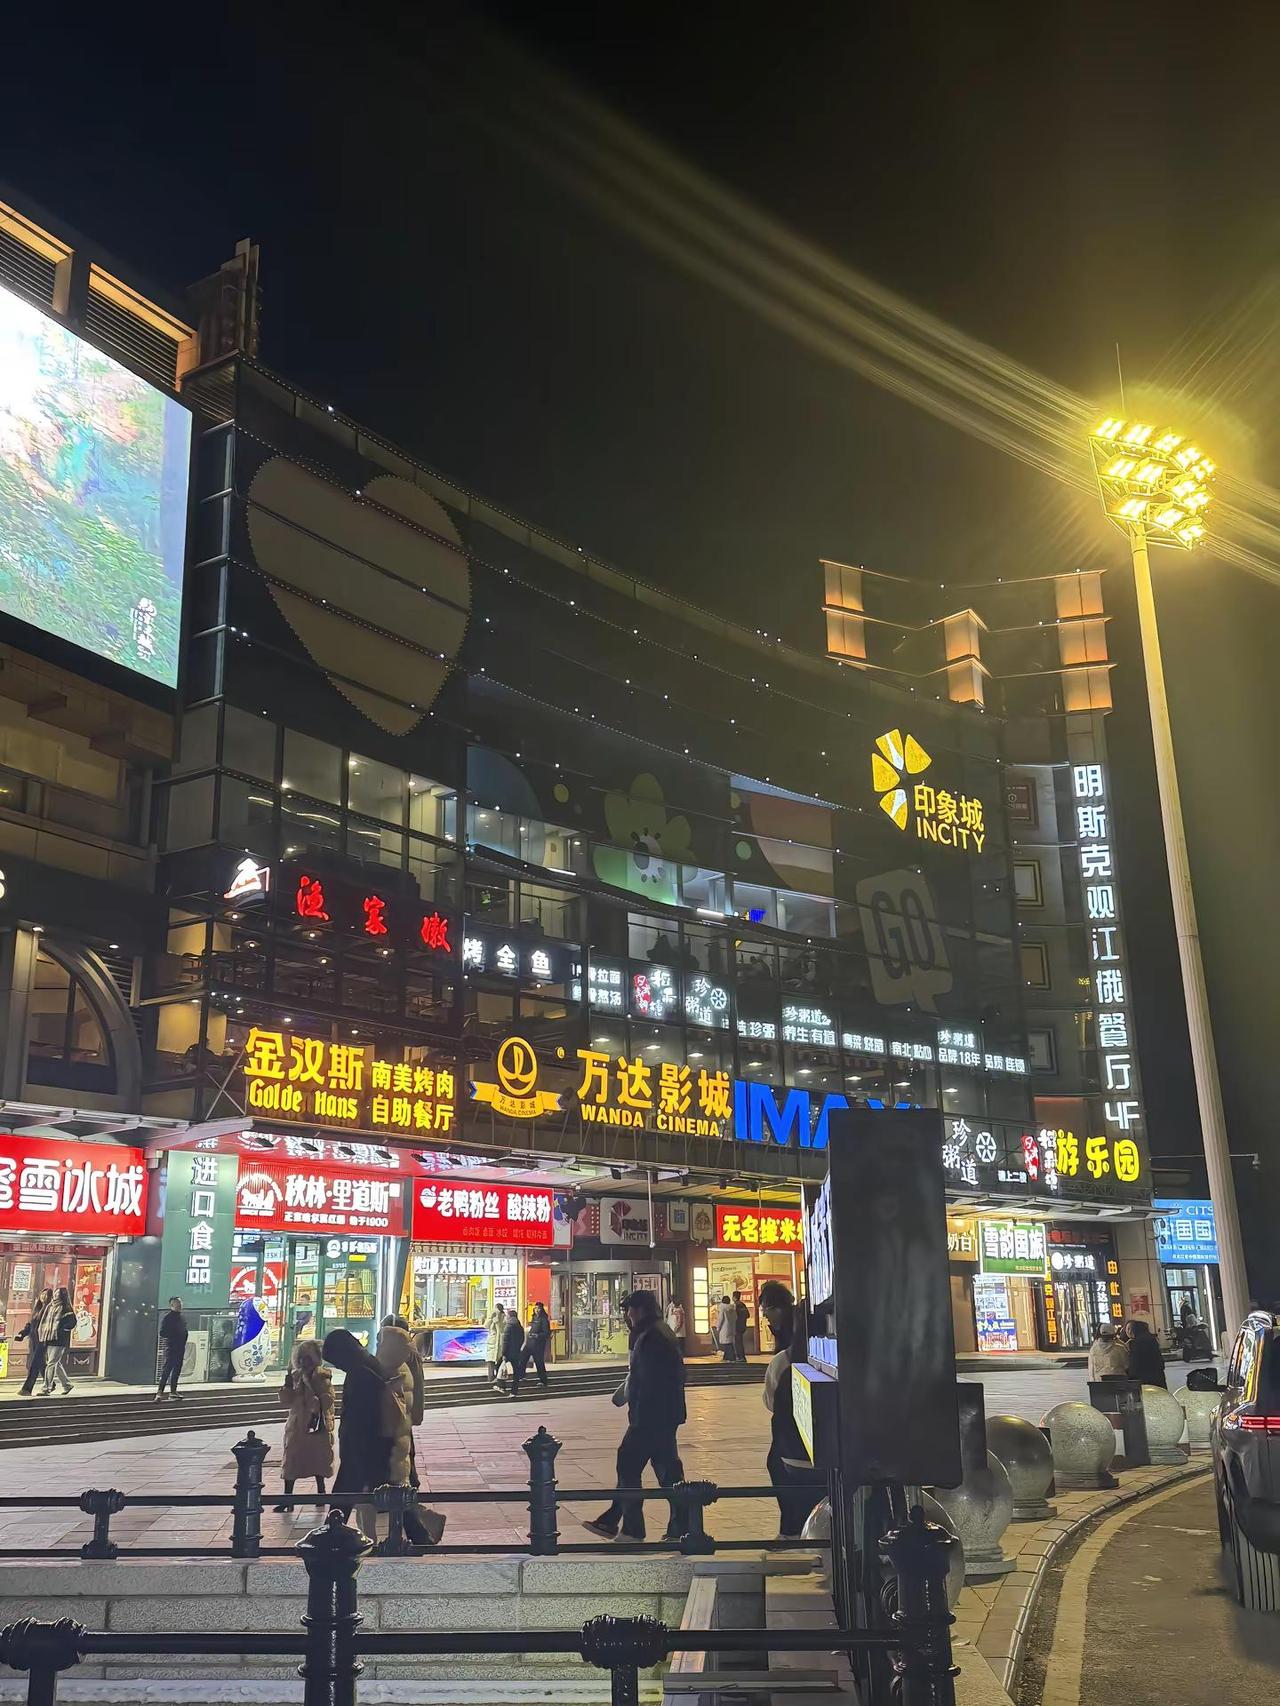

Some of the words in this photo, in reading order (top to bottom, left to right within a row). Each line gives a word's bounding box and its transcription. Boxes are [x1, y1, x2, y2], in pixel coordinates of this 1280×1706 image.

[914, 784, 984, 832] 印象城
[917, 817, 985, 853] INCITY
[463, 937, 551, 975] 烤全鱼
[244, 1027, 365, 1090] 金汉斯
[249, 1078, 303, 1112] Golde
[371, 1059, 454, 1099] 南美烤肉
[577, 1049, 733, 1120] 万达影城
[371, 1094, 454, 1131] 自助餐厅
[581, 1104, 644, 1128] WANDA
[657, 1114, 721, 1137] CINEMA
[942, 1118, 979, 1186] 珍粥道
[1057, 1128, 1140, 1182] 游乐园
[189, 1156, 219, 1284] 进口食品
[437, 1188, 500, 1219] 老鸭粉丝
[507, 1193, 551, 1223] 酸辣粉
